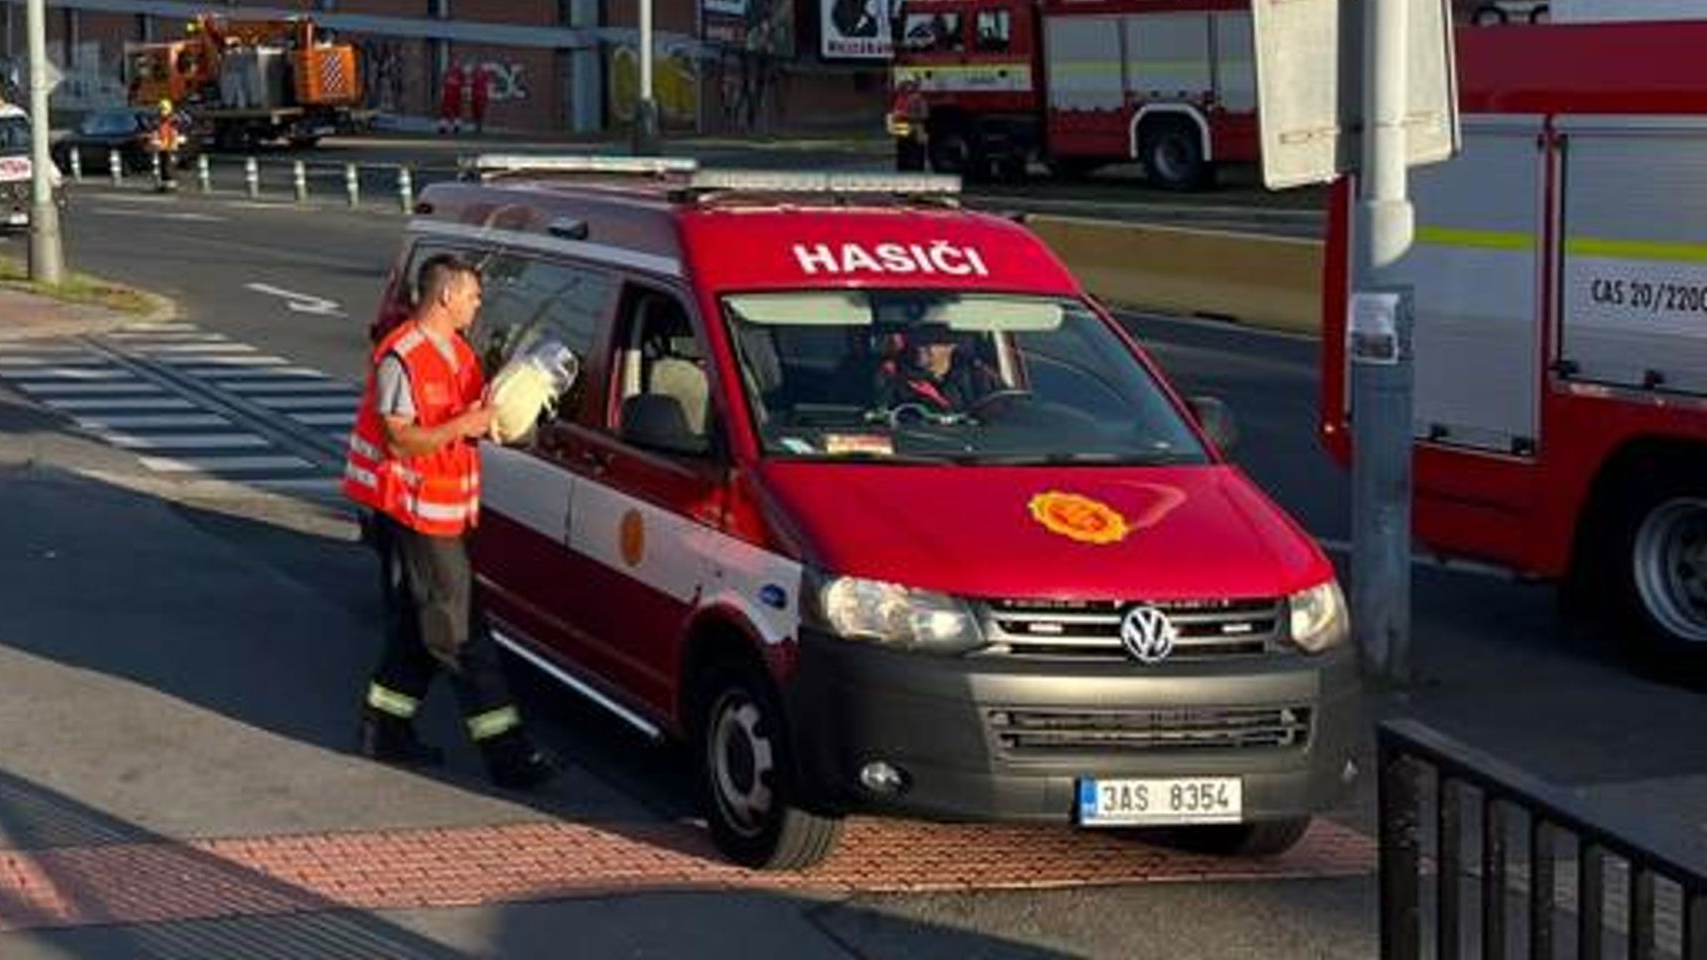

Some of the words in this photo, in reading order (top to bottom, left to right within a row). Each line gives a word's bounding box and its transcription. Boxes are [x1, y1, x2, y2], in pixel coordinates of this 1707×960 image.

[793, 239, 989, 276] HASIČI
[1592, 279, 1624, 305] CAS
[1102, 785, 1150, 812] 3AS
[1169, 783, 1229, 811] 8354
